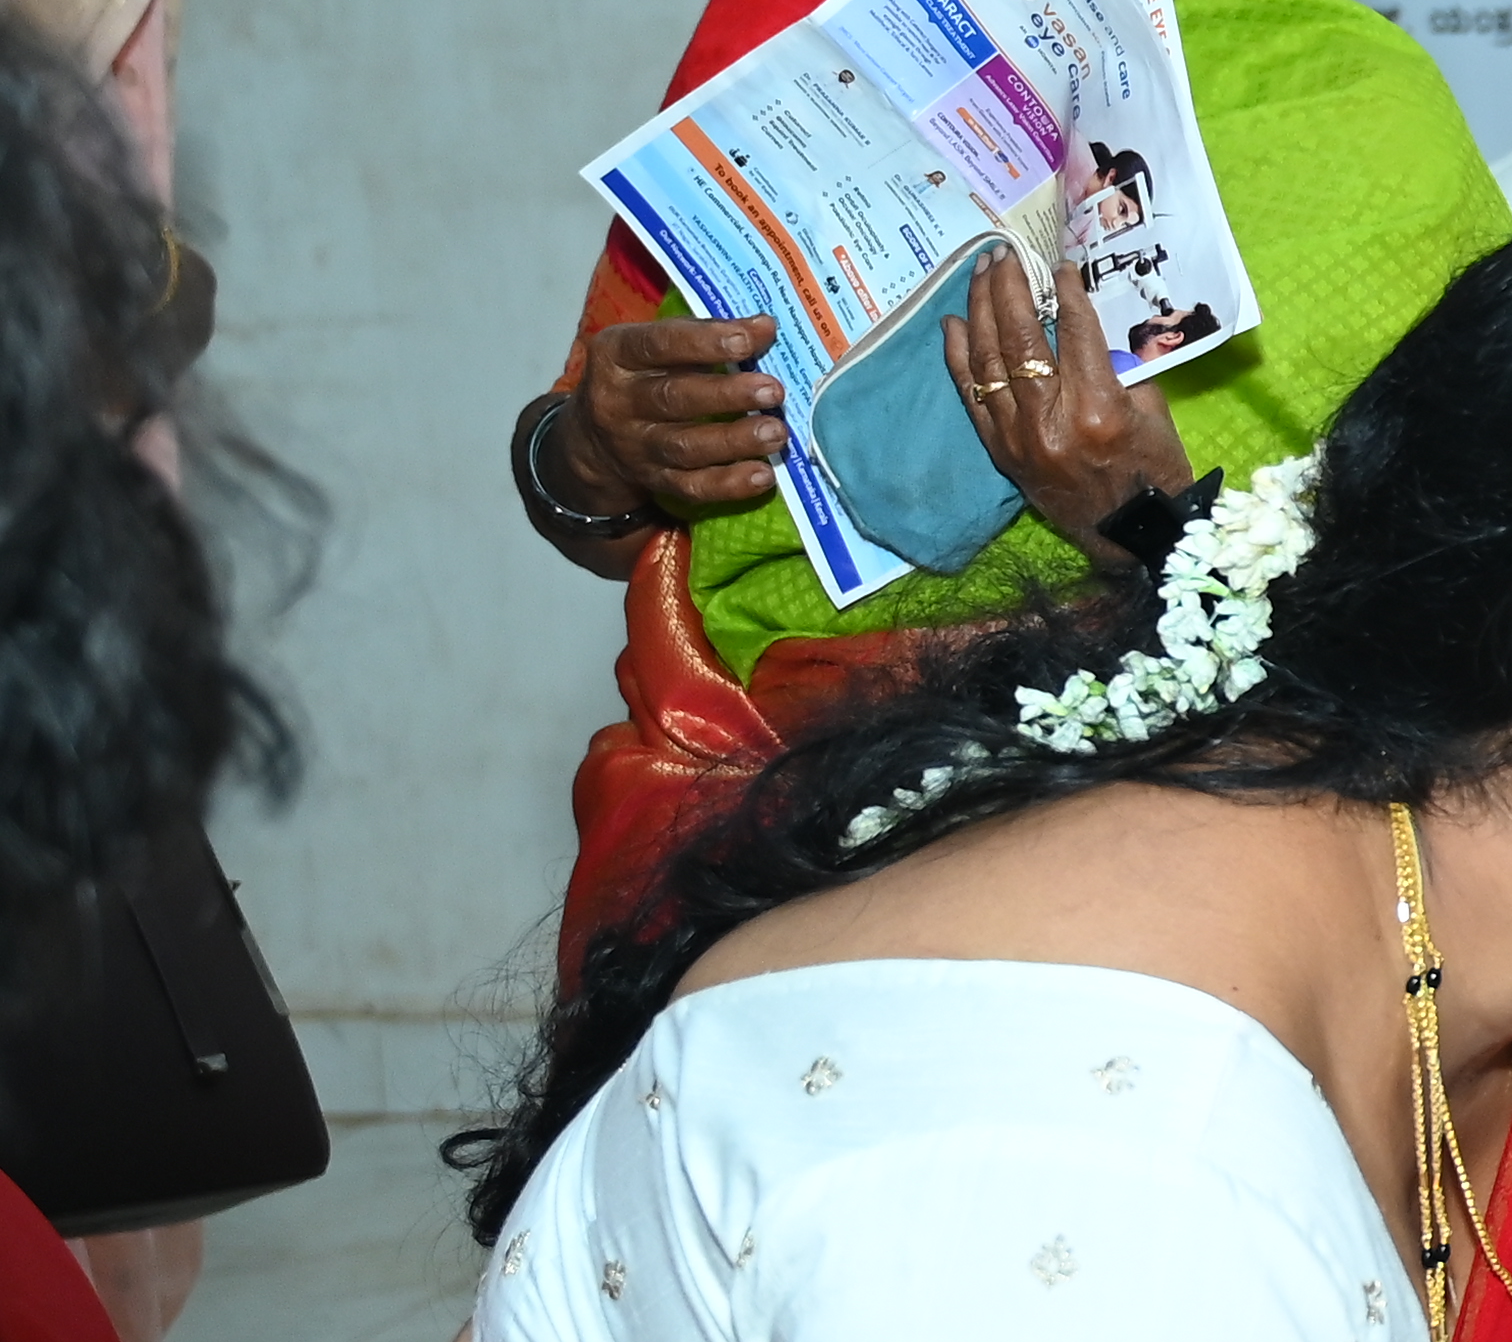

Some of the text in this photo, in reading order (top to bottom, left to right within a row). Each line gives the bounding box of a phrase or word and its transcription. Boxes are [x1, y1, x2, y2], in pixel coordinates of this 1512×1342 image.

[1028, 11, 1086, 120] eye care
[1040, 2, 1097, 80] vasan
[1103, 24, 1125, 56] and
[1116, 60, 1134, 100] care
[1006, 73, 1061, 141] CONTOURA
[1021, 104, 1047, 136] VISION
[691, 214, 731, 261] YASHASWINI
[730, 262, 754, 292] HEALTH
[713, 163, 727, 177] To
[725, 177, 750, 203] book
[747, 204, 760, 217] an
[757, 218, 804, 286] appointment,
[802, 287, 816, 306] call
[813, 307, 822, 321] us
[820, 321, 831, 337] on
[902, 227, 927, 264] SCOPE OF
[694, 273, 717, 300] Andhra
[743, 232, 773, 271] Kuvempu
[777, 285, 790, 306] Near
[788, 306, 810, 345] Nanjappa
[795, 461, 828, 525] Karnataka Kerala
